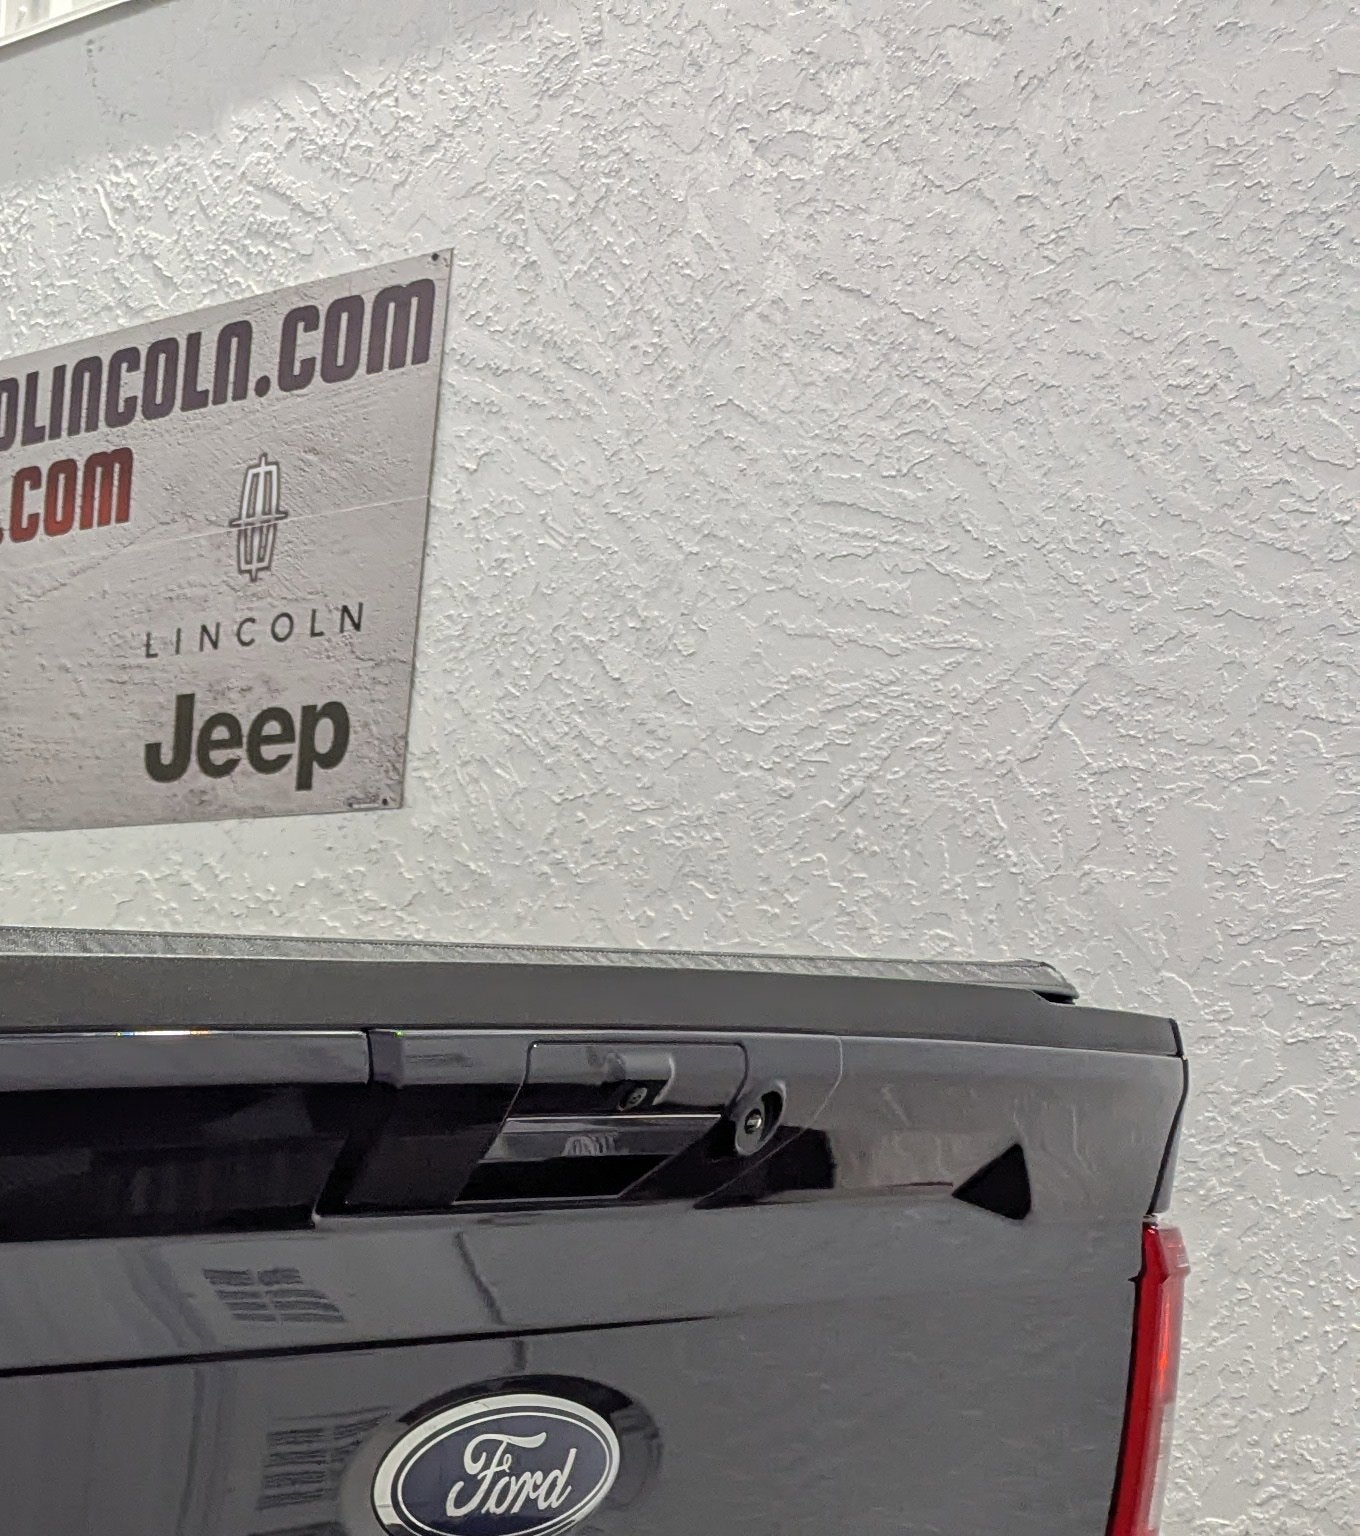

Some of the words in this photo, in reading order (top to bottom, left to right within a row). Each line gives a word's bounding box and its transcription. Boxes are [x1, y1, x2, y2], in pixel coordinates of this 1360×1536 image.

[144, 601, 364, 659] LINCOLN
[144, 692, 351, 792] Jeep
[444, 1431, 578, 1518] Ford
